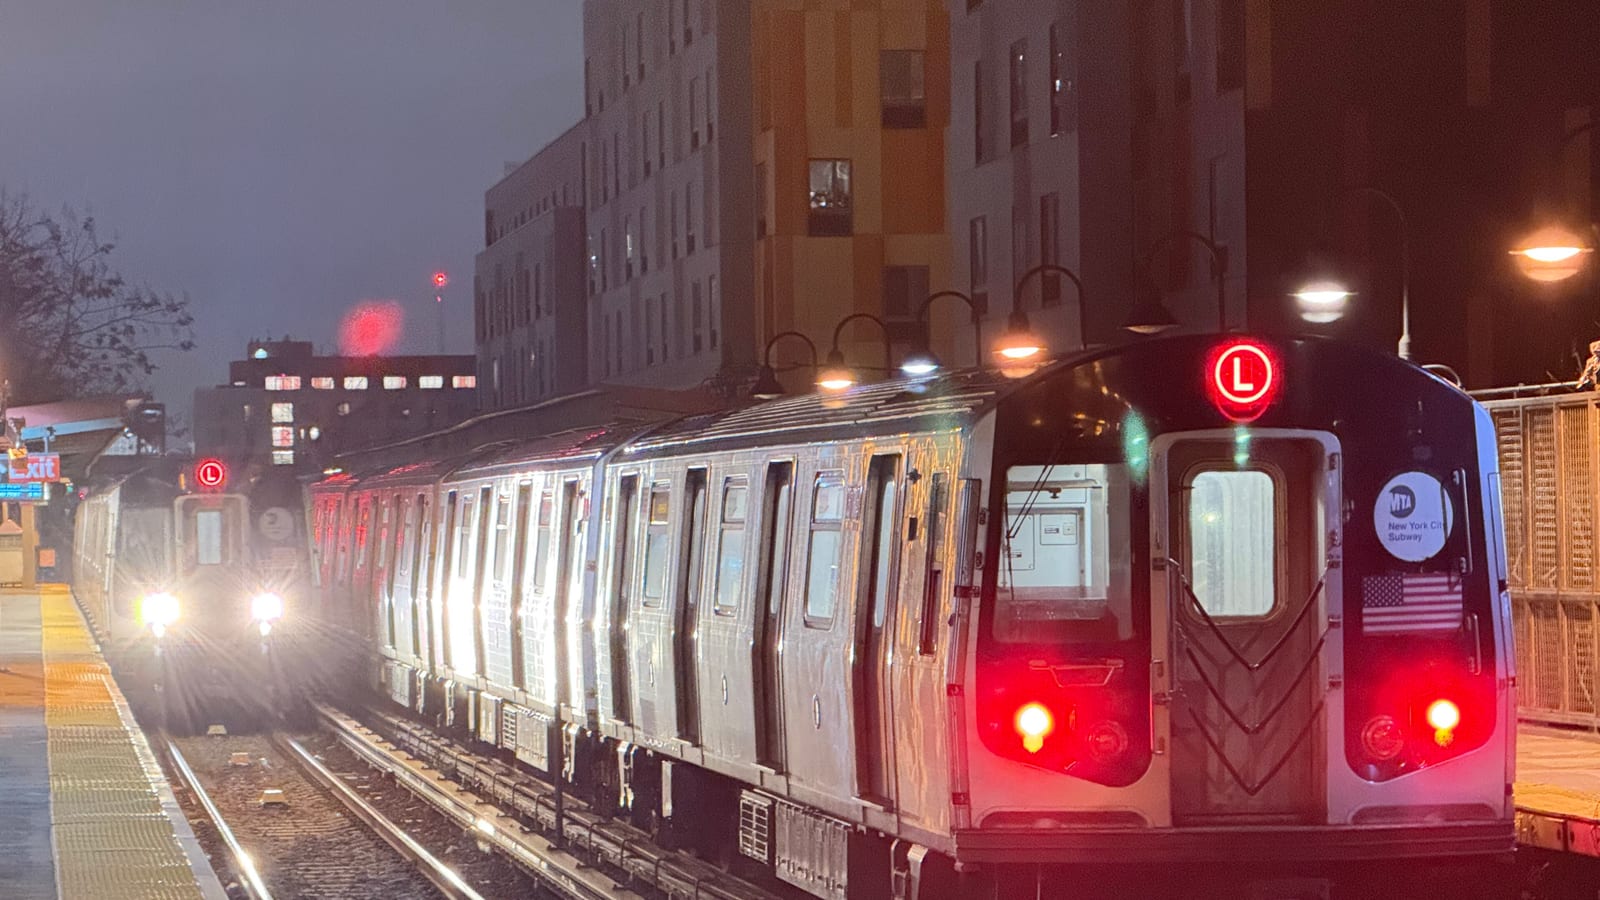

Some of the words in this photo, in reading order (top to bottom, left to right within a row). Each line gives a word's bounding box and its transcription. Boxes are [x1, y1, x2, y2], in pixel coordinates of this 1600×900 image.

[1233, 357, 1254, 391] L
[207, 467, 217, 481] L
[1389, 491, 1413, 512] MTA
[1388, 522, 1407, 530] New
[1409, 521, 1428, 529] York
[1430, 521, 1442, 529] Cit
[1388, 532, 1422, 542] Subway
